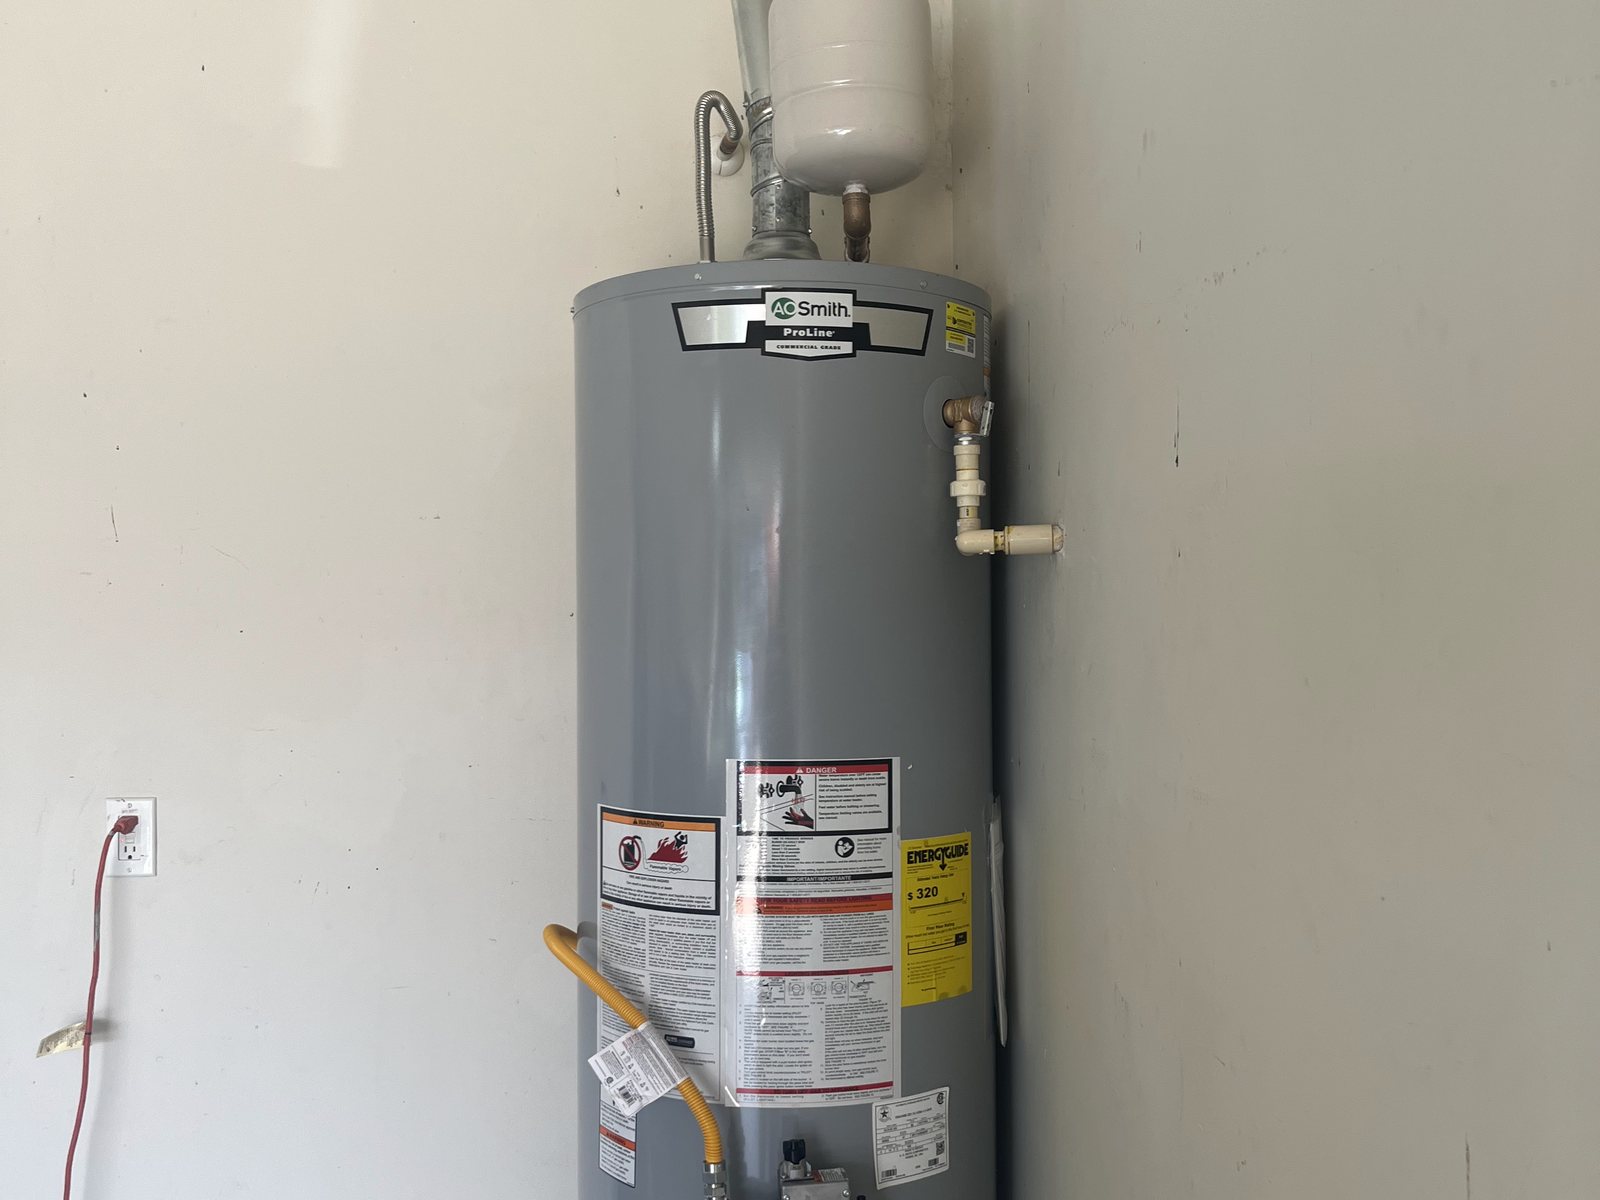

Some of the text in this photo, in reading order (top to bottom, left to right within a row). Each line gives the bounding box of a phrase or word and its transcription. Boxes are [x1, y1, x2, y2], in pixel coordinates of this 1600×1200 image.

[783, 327, 834, 338] ProLine
[806, 766, 837, 774] DANGER
[638, 820, 665, 828] WARNING
[907, 843, 969, 865] ENERGYGUIDE
[907, 886, 939, 901] $ 320
